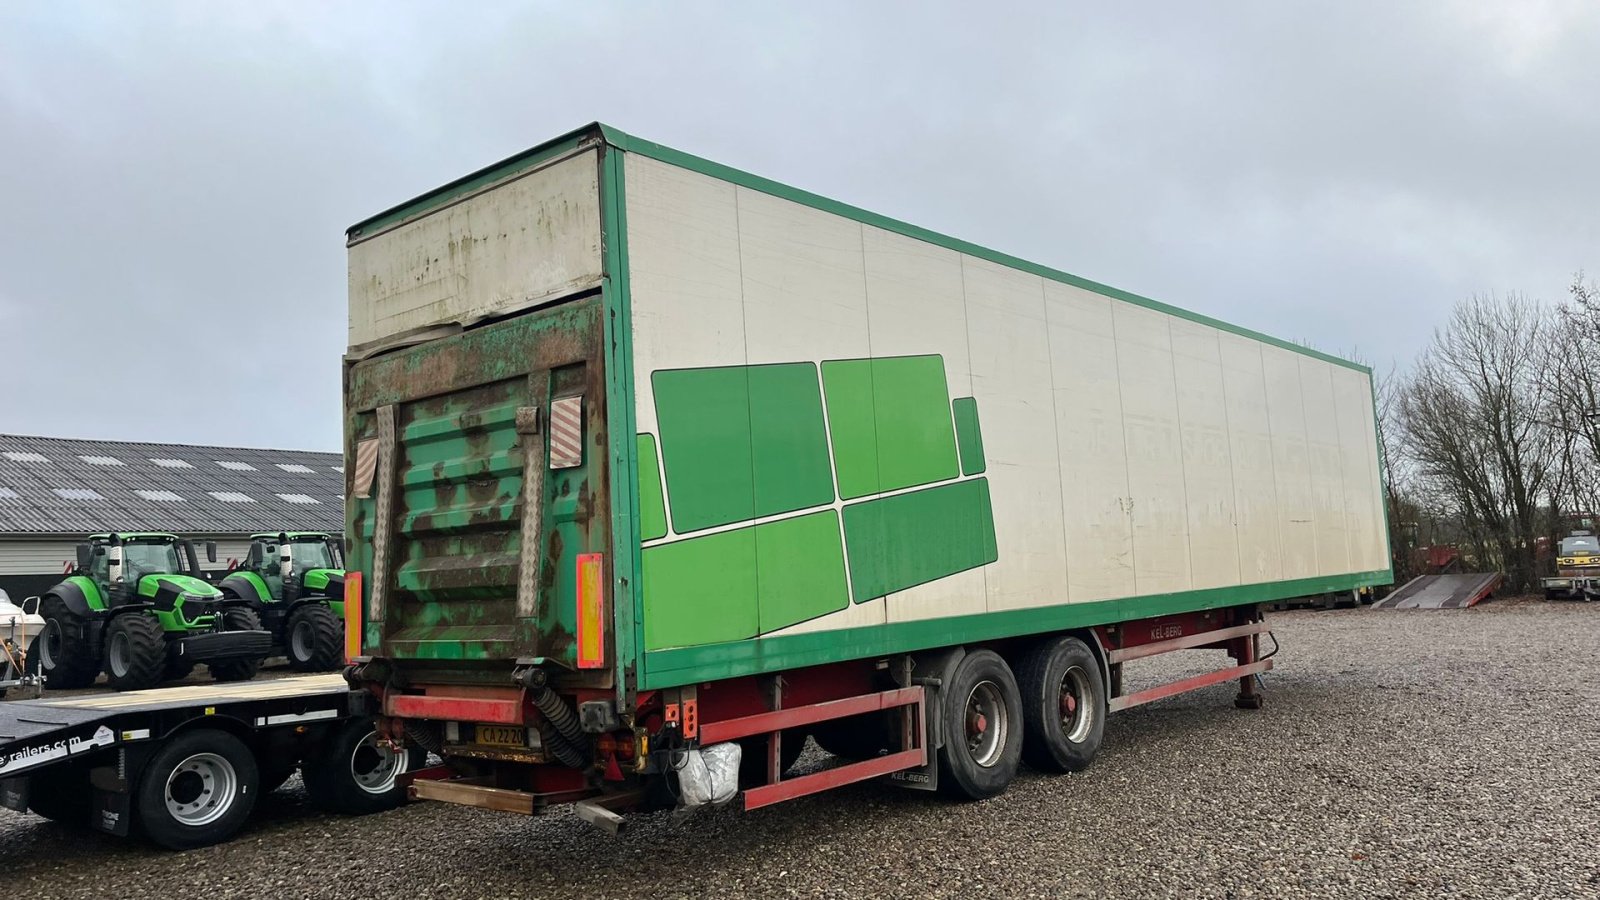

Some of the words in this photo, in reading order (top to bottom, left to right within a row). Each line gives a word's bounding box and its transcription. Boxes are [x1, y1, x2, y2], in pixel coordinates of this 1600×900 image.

[1150, 625, 1182, 640] KEL-BERG
[483, 727, 496, 743] CA
[498, 728, 509, 743] 22
[511, 729, 523, 744] 20
[891, 771, 929, 783] KEL-BERG
